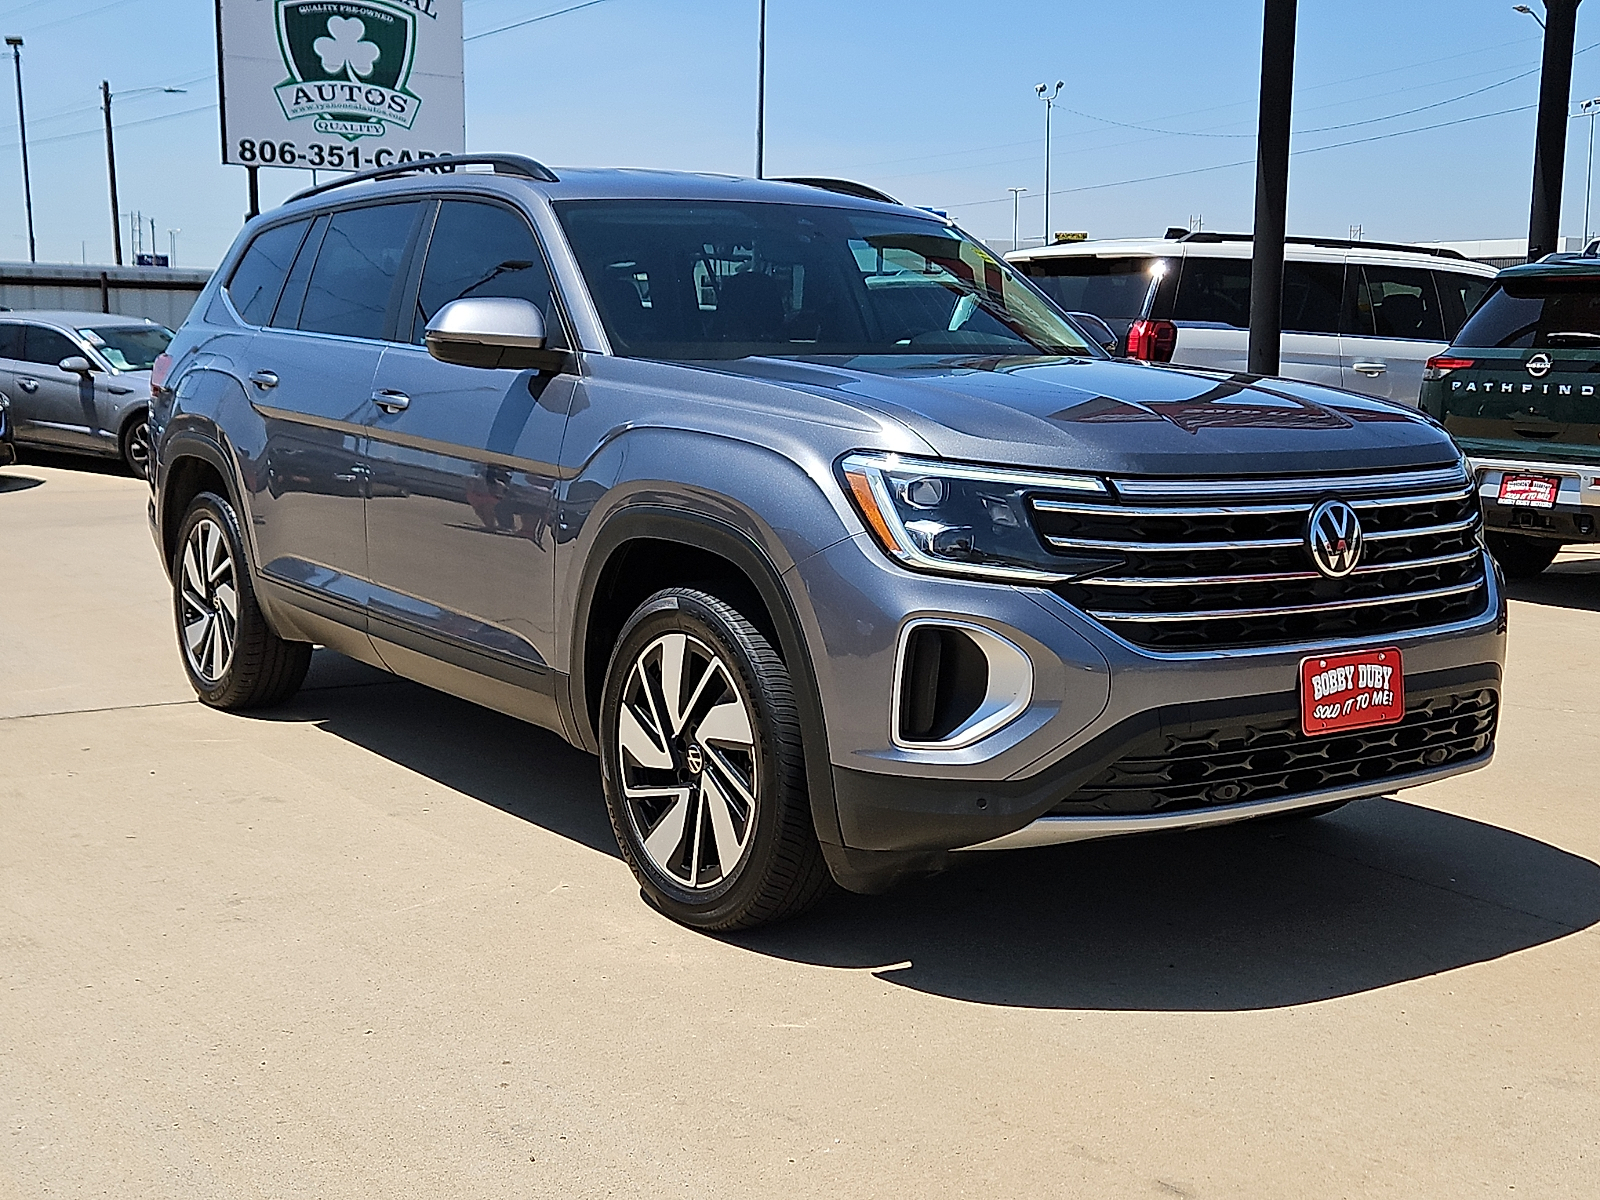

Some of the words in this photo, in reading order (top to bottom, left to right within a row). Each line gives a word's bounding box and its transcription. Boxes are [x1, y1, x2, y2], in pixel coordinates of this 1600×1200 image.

[299, 4, 338, 15] QUALITY
[340, 5, 394, 23] PRE-OWNED
[293, 84, 407, 113] AUTOS
[318, 121, 380, 133] QUALITY
[1310, 500, 1362, 577] VW
[1312, 665, 1354, 700] BOBBY
[1358, 664, 1392, 690] DUBY
[1313, 704, 1340, 719] SOLD
[1343, 698, 1355, 716] IT
[1356, 693, 1370, 711] TO
[1372, 690, 1393, 706] ME!
